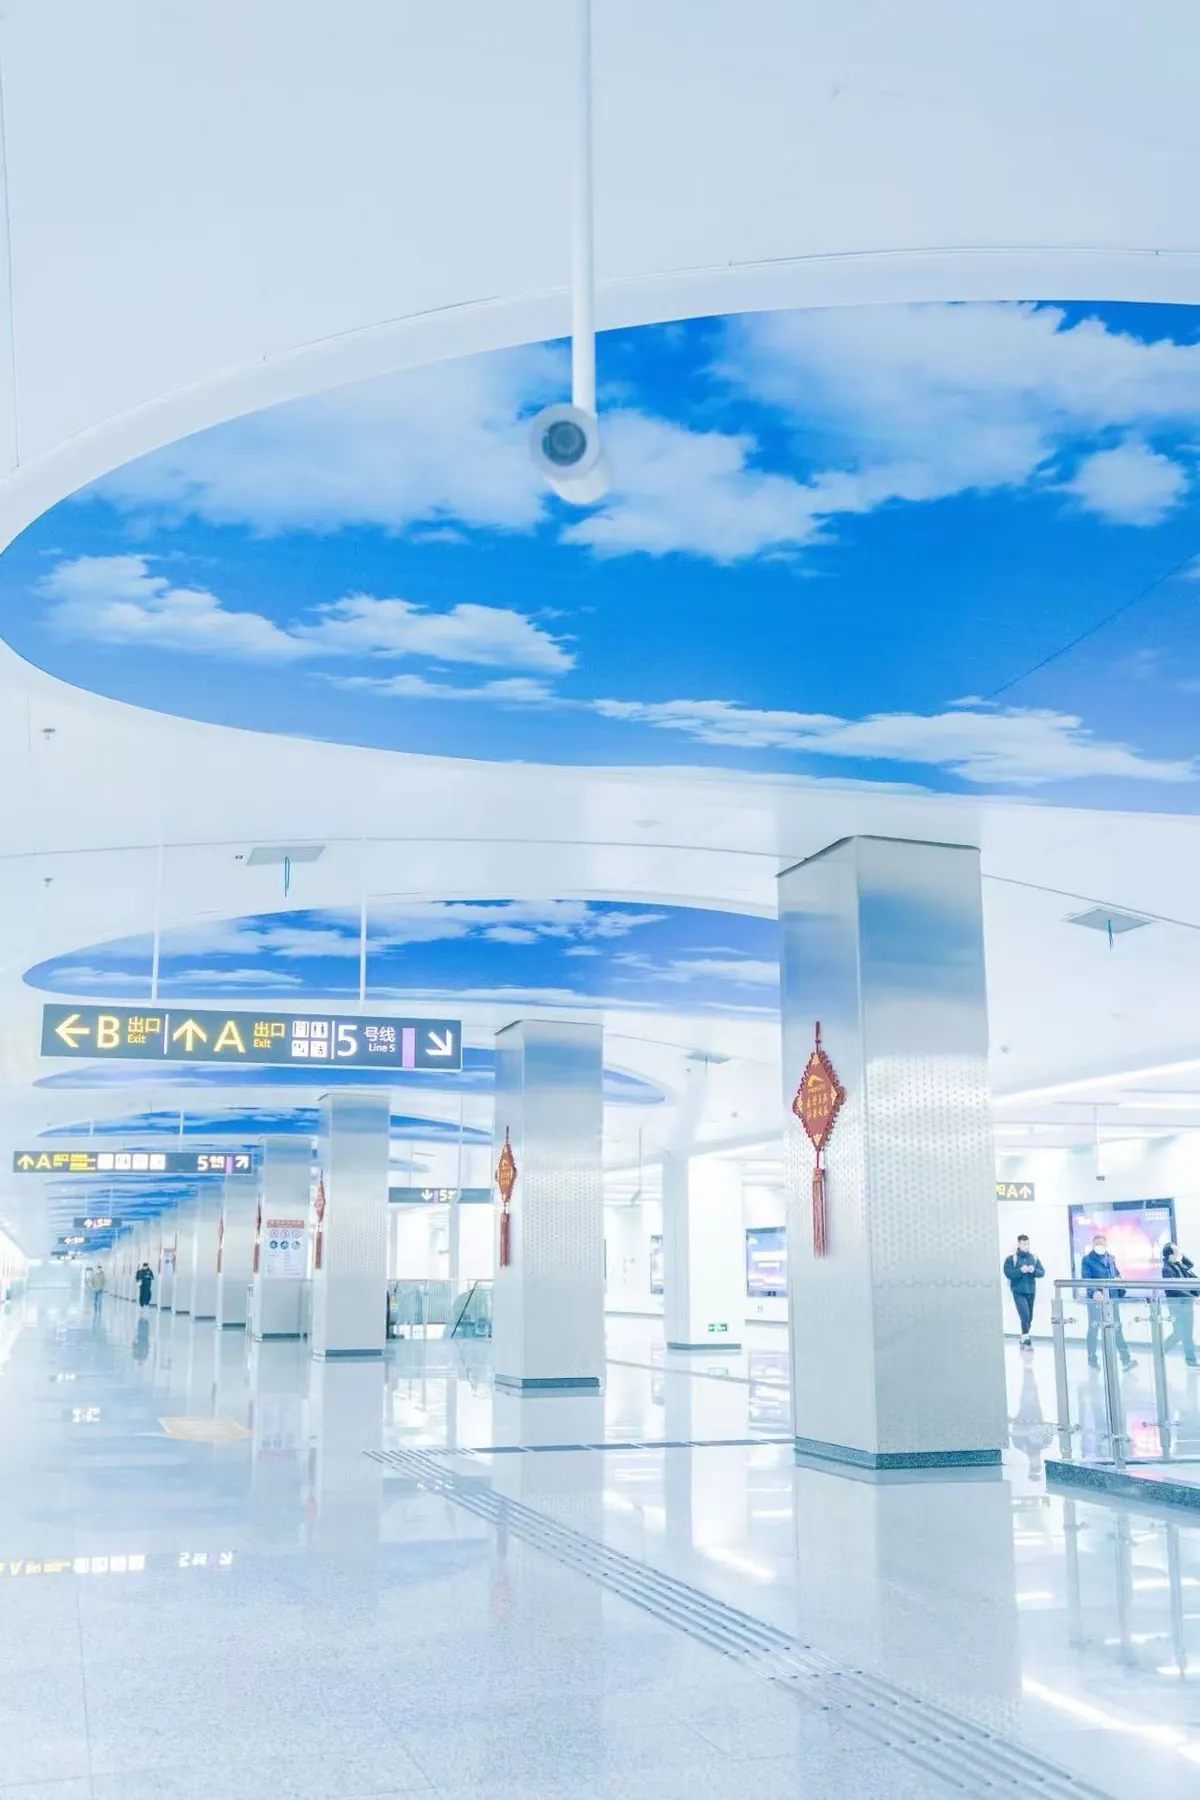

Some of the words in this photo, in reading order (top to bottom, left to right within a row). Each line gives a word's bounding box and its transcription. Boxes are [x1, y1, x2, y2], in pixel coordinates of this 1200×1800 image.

[97, 1015, 120, 1048] B
[127, 1016, 161, 1033] 出口
[127, 1034, 148, 1044] Exit
[213, 1020, 246, 1054] A
[253, 1021, 286, 1038] 出口
[253, 1039, 272, 1049] Exit
[337, 1024, 358, 1057] 5
[363, 1026, 397, 1043] 号线
[368, 1043, 388, 1053] Line
[389, 1043, 396, 1053] 5
[36, 1153, 52, 1169] A
[198, 1155, 208, 1170] 5
[440, 1189, 448, 1201] 5
[1006, 1183, 1018, 1198] A
